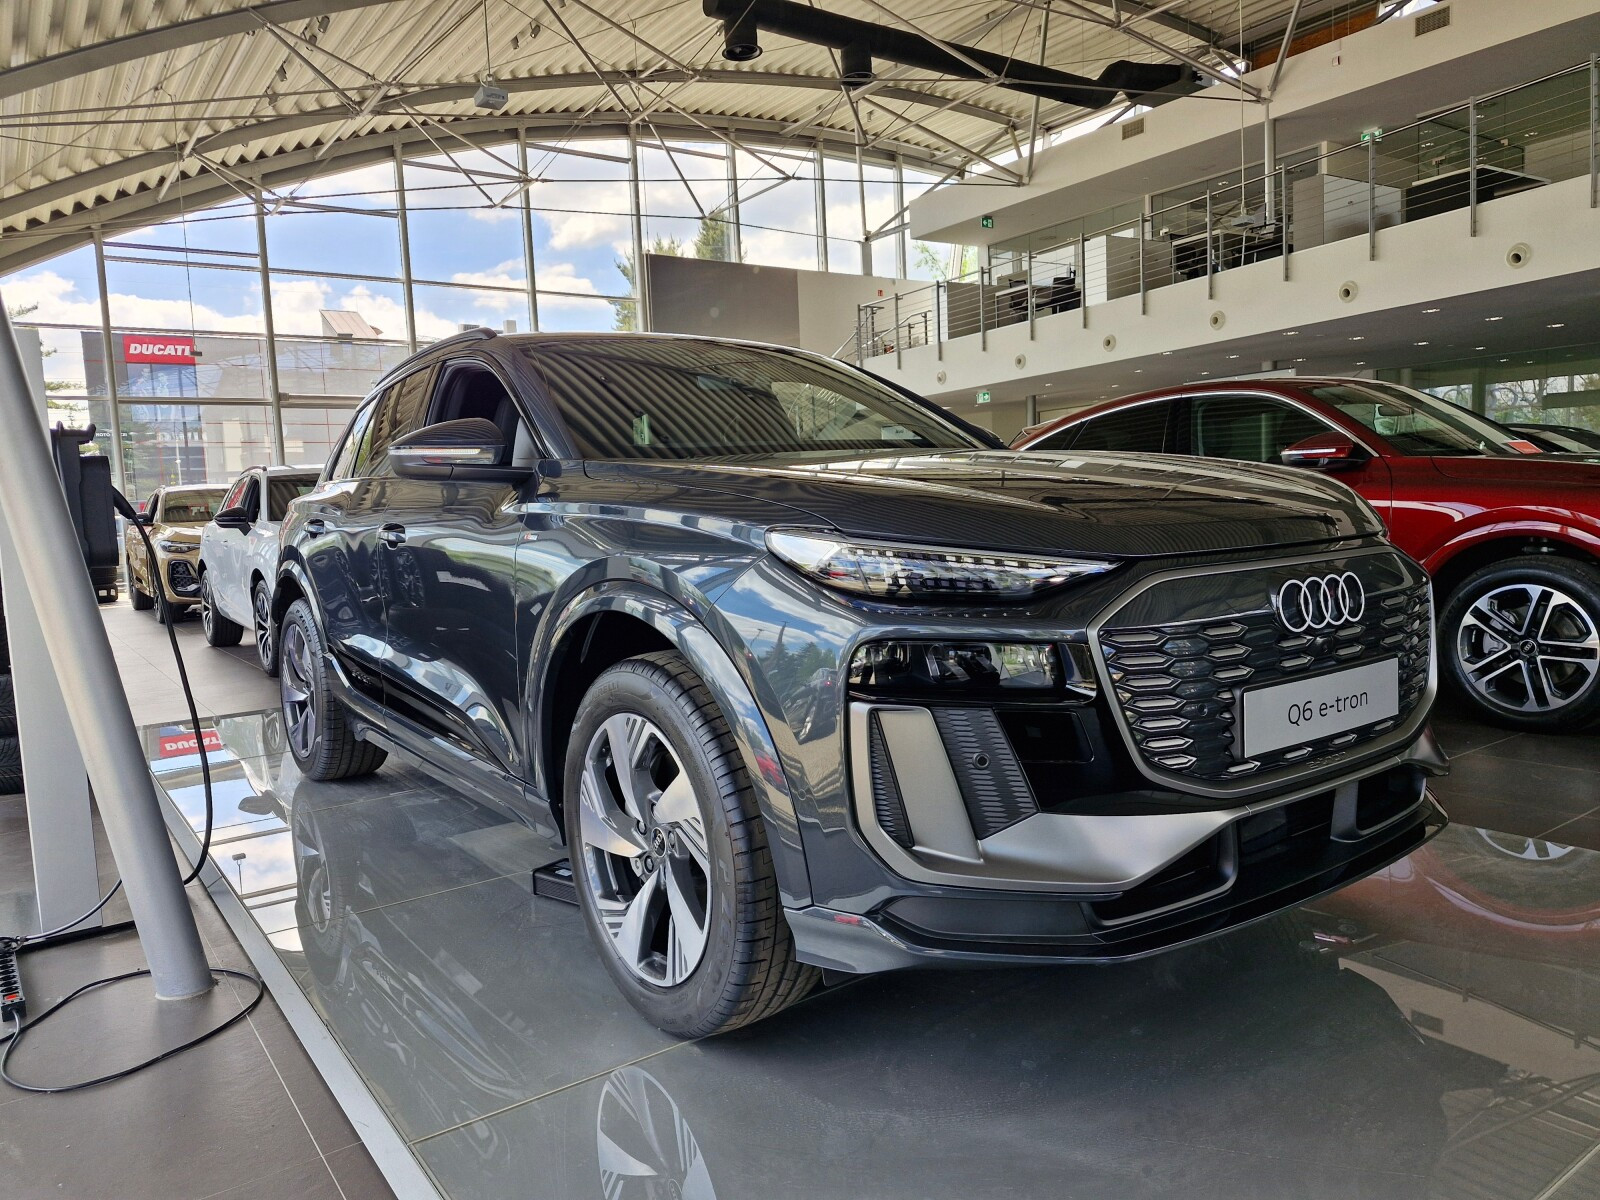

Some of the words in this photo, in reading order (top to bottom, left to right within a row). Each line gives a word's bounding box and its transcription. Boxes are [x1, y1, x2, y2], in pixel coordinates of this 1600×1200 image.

[129, 344, 190, 355] DUCATI
[1288, 701, 1313, 726] Q6
[1319, 692, 1368, 717] e-tron
